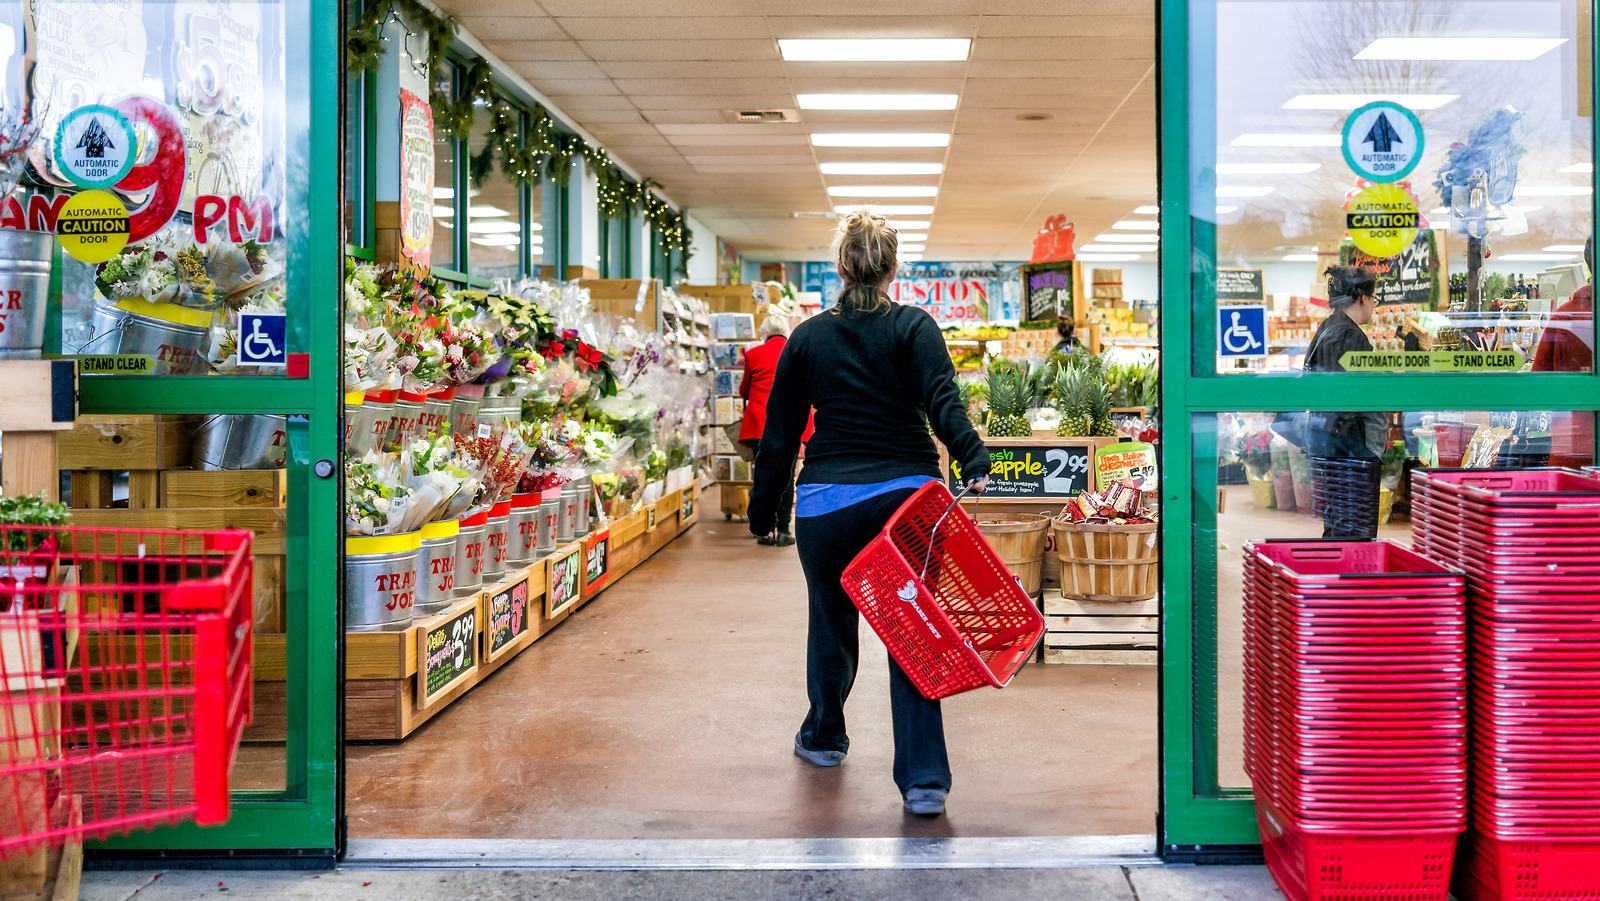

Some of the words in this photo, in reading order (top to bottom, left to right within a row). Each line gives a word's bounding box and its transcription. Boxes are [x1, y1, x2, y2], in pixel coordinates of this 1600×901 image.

[30, 15, 72, 46] VALUE
[1362, 154, 1407, 162] AUTOMATIC
[74, 159, 118, 168] AUTOMATIC
[1373, 163, 1396, 171] DOOR
[85, 169, 108, 177] DOOR
[1356, 202, 1412, 211] AUTOMATIC
[66, 208, 122, 217] AUTOMATIC
[193, 194, 273, 245] PM
[1351, 214, 1416, 227] CAUTION
[62, 219, 126, 233] CAUTION
[1369, 230, 1398, 238] DOOR
[80, 235, 108, 244] DOOR
[0, 290, 22, 310] R
[84, 358, 114, 370] STAND
[117, 358, 146, 370] CLEAR
[1350, 355, 1402, 367] AUTOMATIC
[1405, 355, 1430, 367] DOOR
[1453, 355, 1483, 367] STAND
[1487, 355, 1515, 367] CLEAR
[1100, 454, 1120, 464] Fresh
[1013, 480, 1040, 488] pineapple
[998, 485, 1017, 493] Holiday
